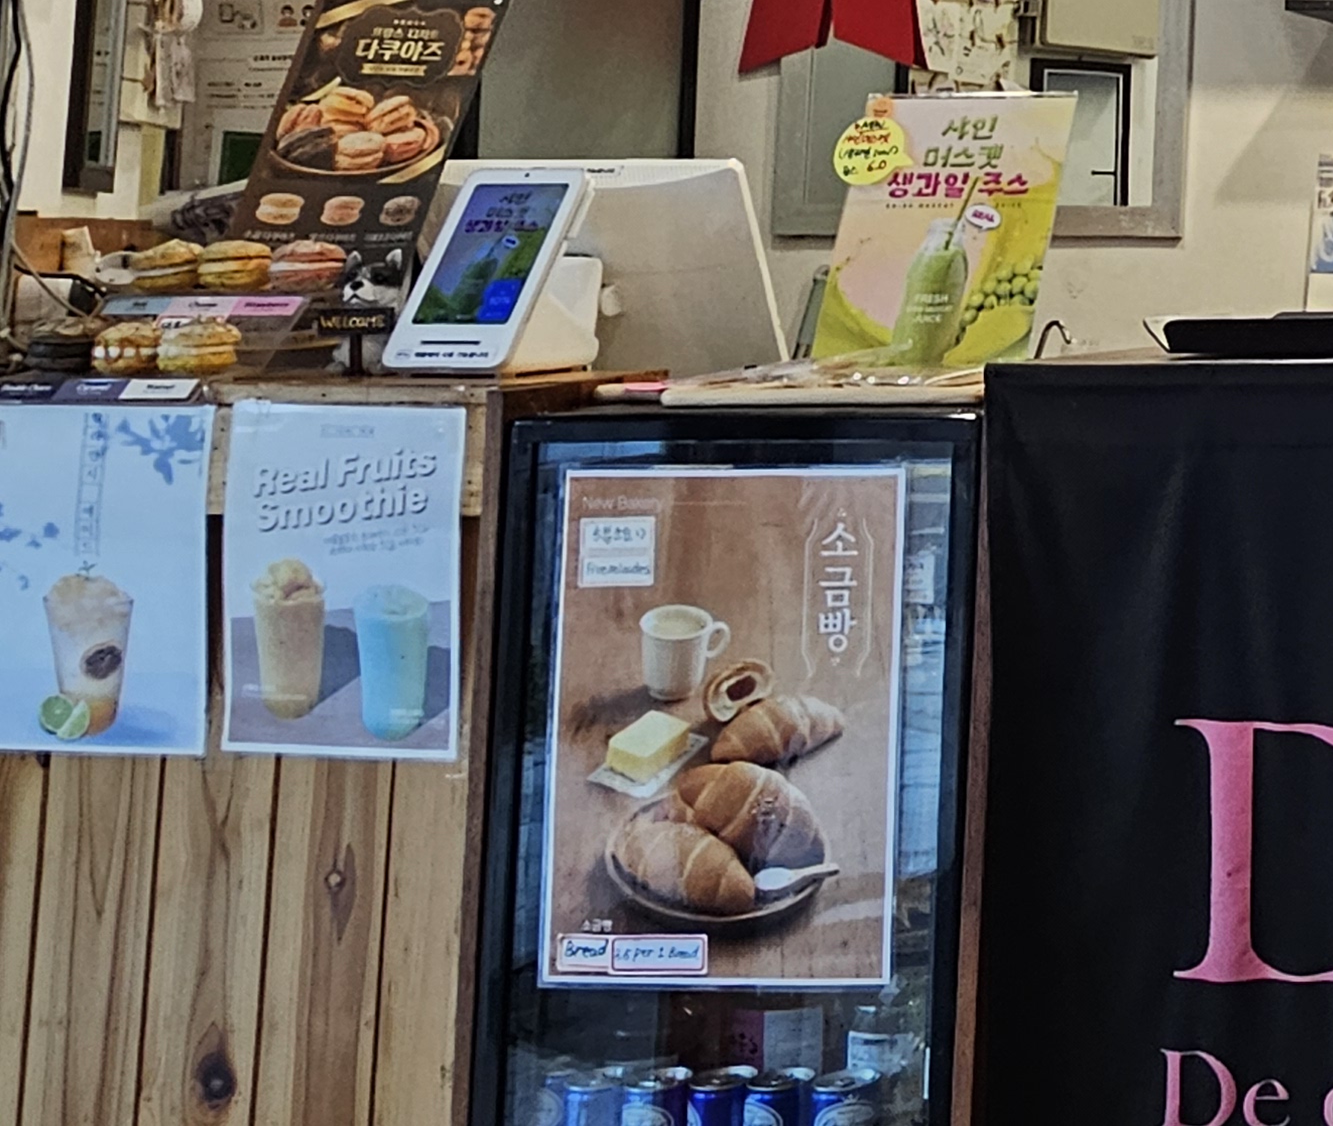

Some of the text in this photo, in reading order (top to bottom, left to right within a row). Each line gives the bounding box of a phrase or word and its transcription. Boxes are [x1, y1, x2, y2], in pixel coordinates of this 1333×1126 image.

[354, 38, 446, 62] 다쿠아즈
[886, 171, 1030, 199] 생과일 주스
[319, 314, 386, 329] WELCOME
[252, 447, 438, 498] Real Fruits
[257, 485, 430, 533] Smoothie
[817, 520, 861, 654] 소금빵
[1160, 1048, 1290, 1125] De
